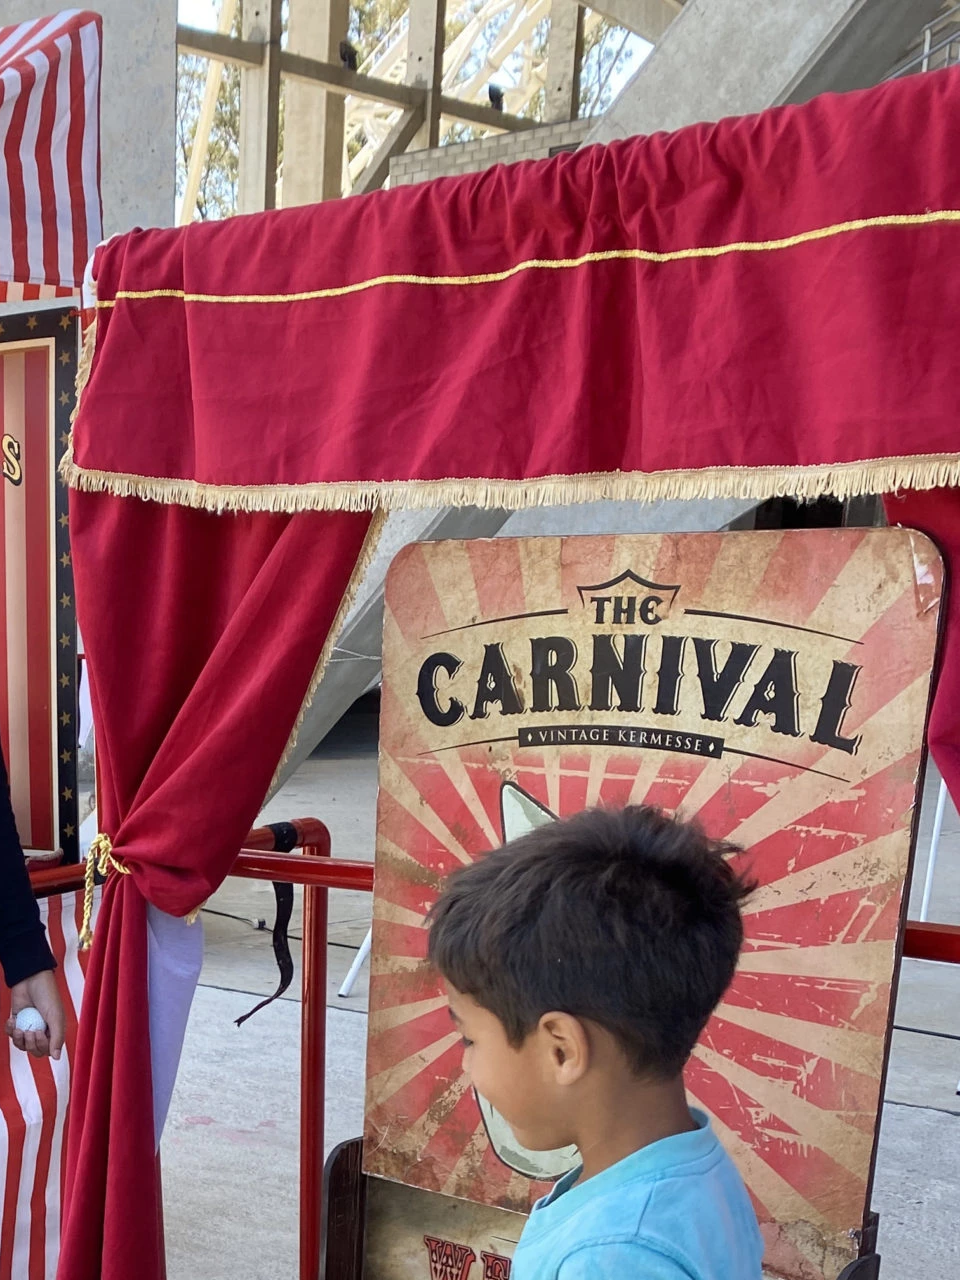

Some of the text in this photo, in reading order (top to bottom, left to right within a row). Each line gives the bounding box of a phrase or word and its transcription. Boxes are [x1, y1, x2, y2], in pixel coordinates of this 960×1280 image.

[589, 594, 662, 625] THE
[416, 633, 864, 756] CARNIVAL
[538, 728, 703, 752] VINTAGE KERMESSE
